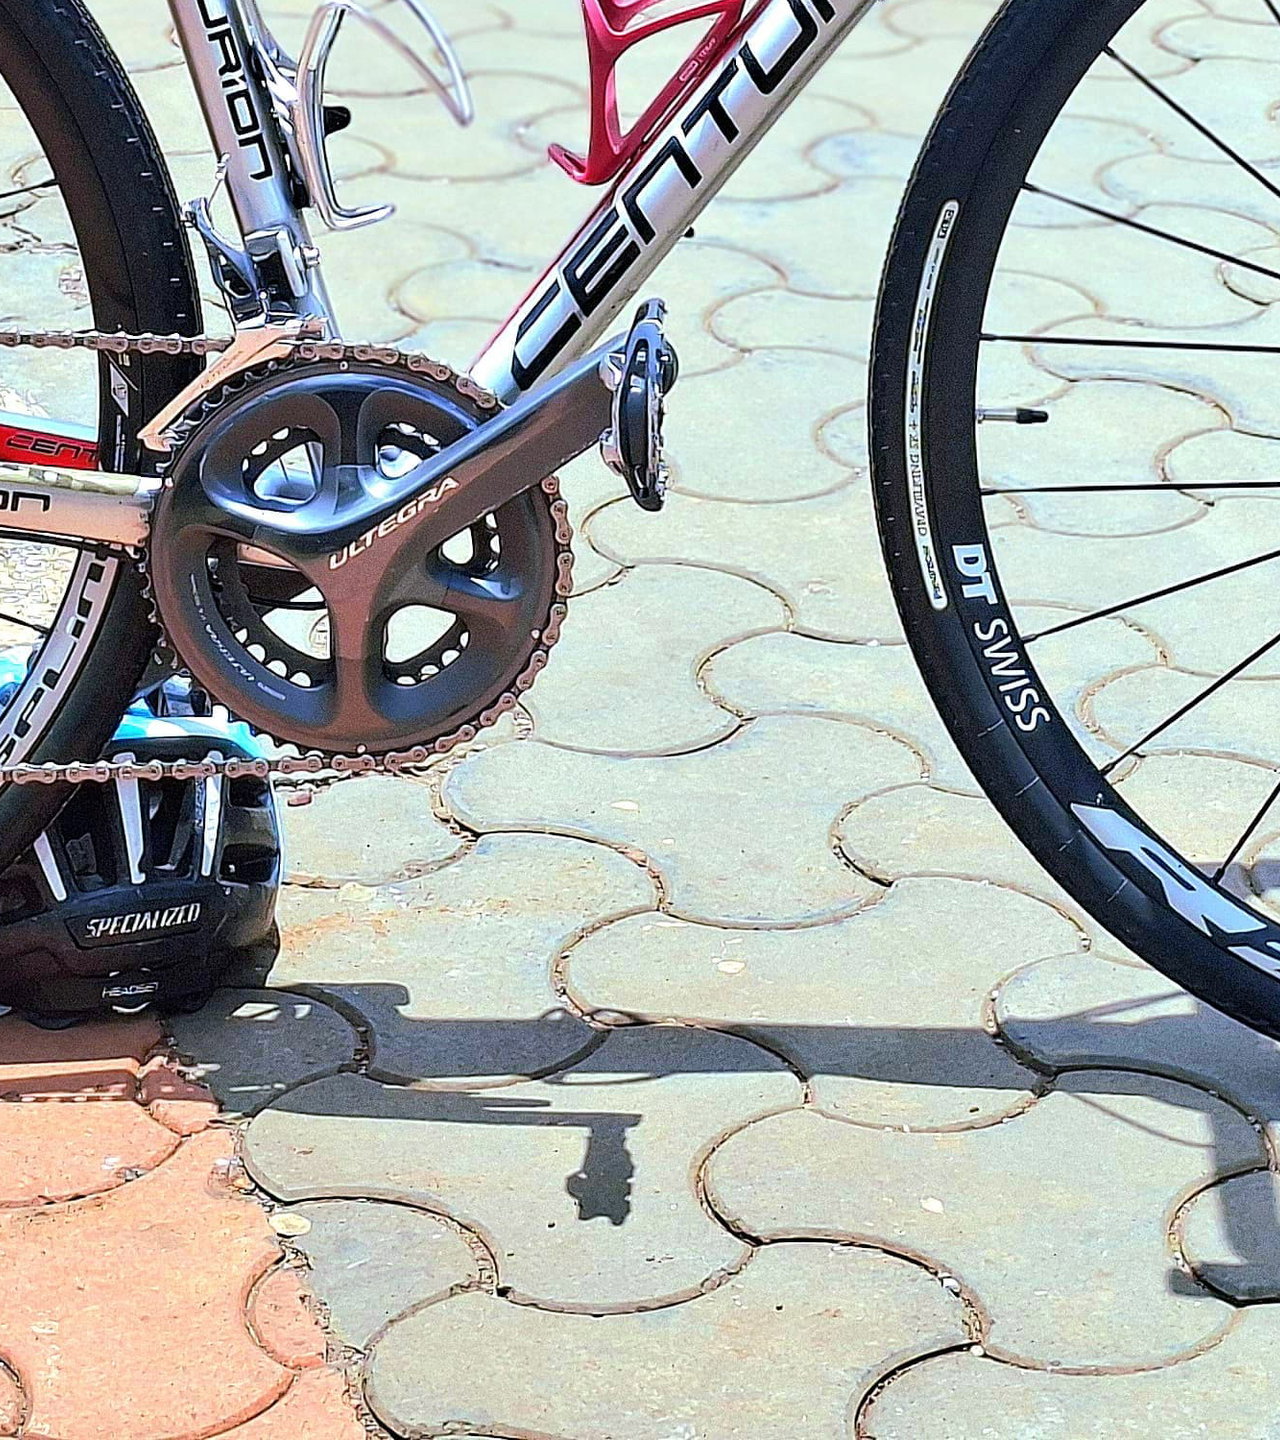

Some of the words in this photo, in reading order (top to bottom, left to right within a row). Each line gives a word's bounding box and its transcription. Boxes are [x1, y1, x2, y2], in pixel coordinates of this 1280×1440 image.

[329, 475, 459, 570] ULTEGRA
[951, 544, 995, 606] DT
[970, 618, 1053, 734] SWISS
[85, 903, 200, 939] SPECIALIZED
